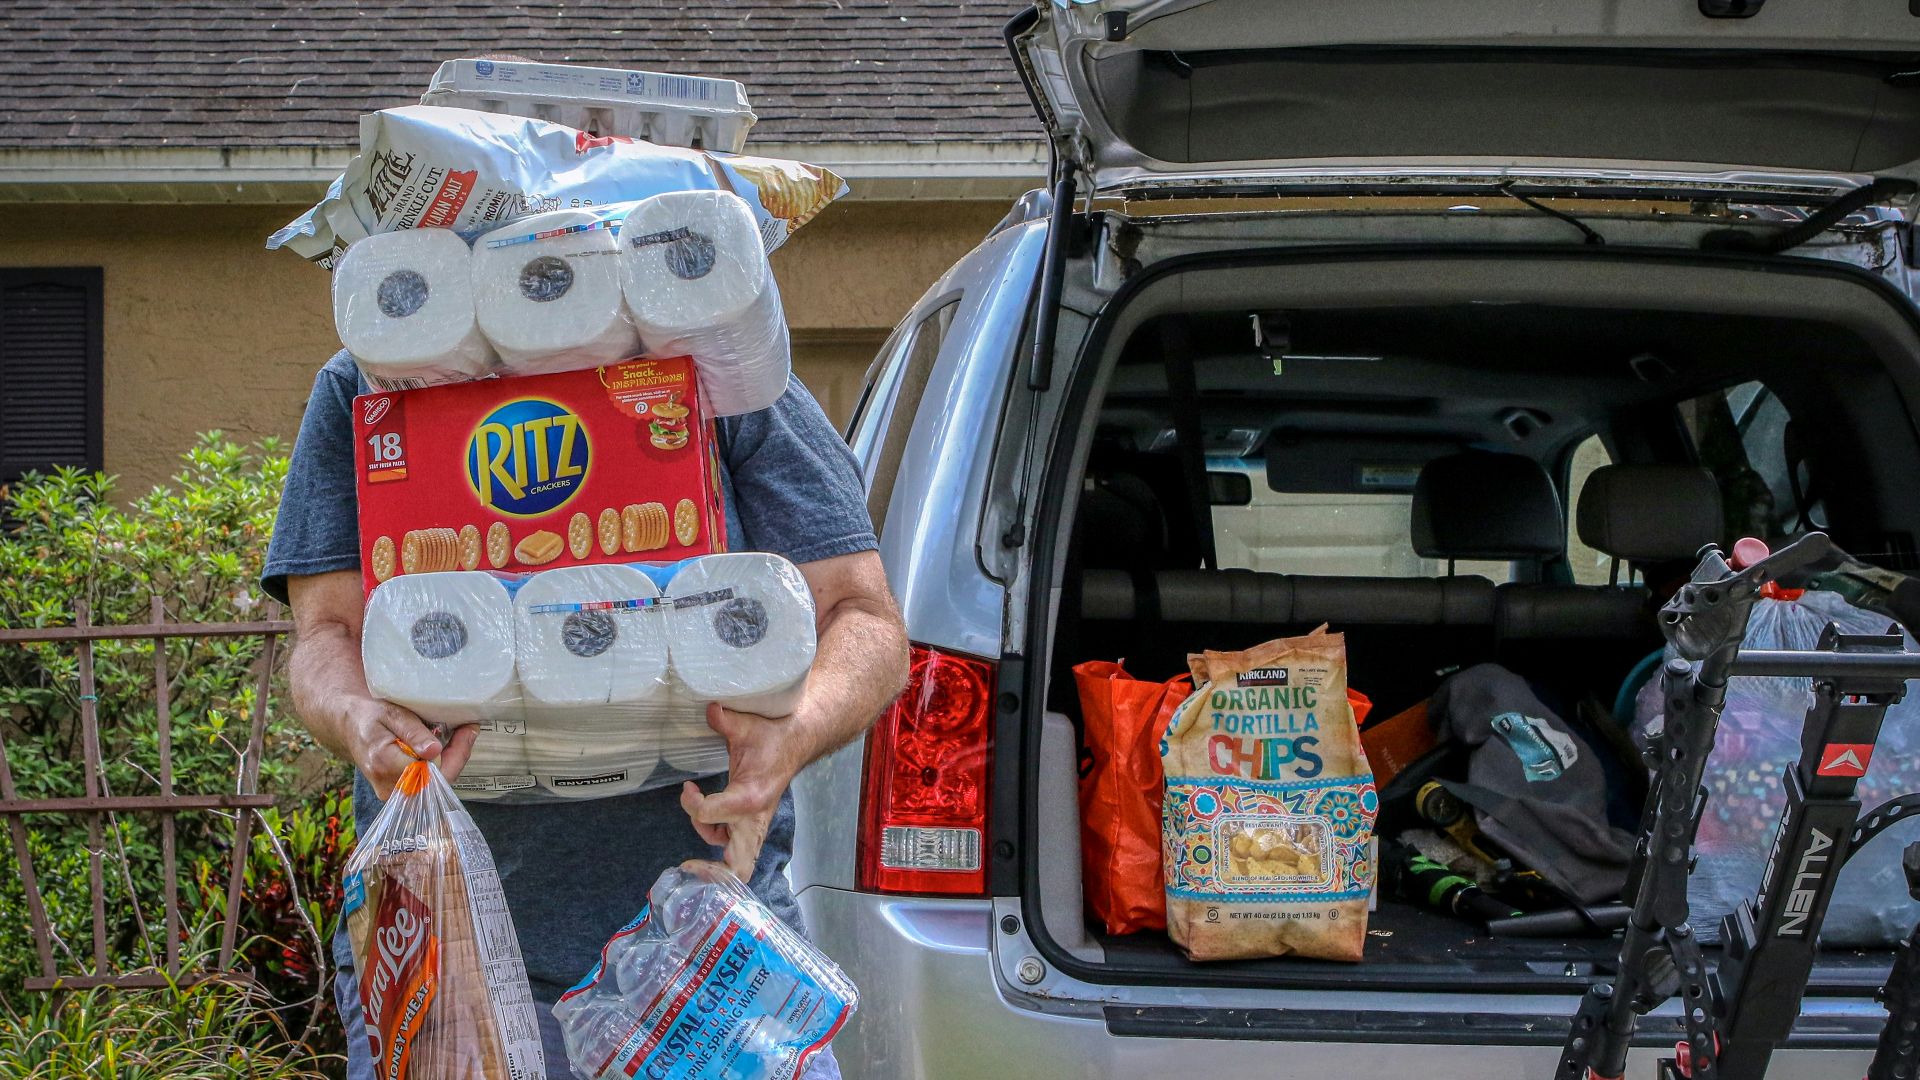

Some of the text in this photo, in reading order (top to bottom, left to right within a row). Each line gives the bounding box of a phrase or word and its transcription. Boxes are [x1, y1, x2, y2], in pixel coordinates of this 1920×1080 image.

[394, 185, 416, 214] BRAND
[425, 200, 448, 228] ALAYAN
[443, 177, 463, 201] SALT
[623, 368, 655, 379] Snack
[367, 400, 388, 422] NABISCO
[368, 433, 402, 461] 18
[475, 414, 582, 506] RITZ
[531, 480, 571, 494] CRACKERS
[1239, 670, 1287, 680] KIRKLAND
[1211, 686, 1317, 711] ORGANIC
[1211, 712, 1319, 735] TORTILLA
[1208, 734, 1323, 780] CHIPS
[558, 775, 622, 786] KIRKLAND
[1778, 827, 1833, 937] ALLEN
[1271, 912, 1277, 920] (2
[1313, 912, 1321, 921] kg
[376, 907, 424, 986] Lee
[400, 983, 429, 1031] WHEAT
[643, 946, 722, 1055] BOTTLED AT THE SOURCE
[645, 942, 755, 1080] CRYSTAL GEYSER
[686, 988, 744, 1060] NATURAL
[689, 966, 770, 1080] PINE SPRING WATER
[618, 1033, 641, 1062] CRYSTAL
[721, 1052, 728, 1060] BY
[727, 1043, 735, 1053] CG
